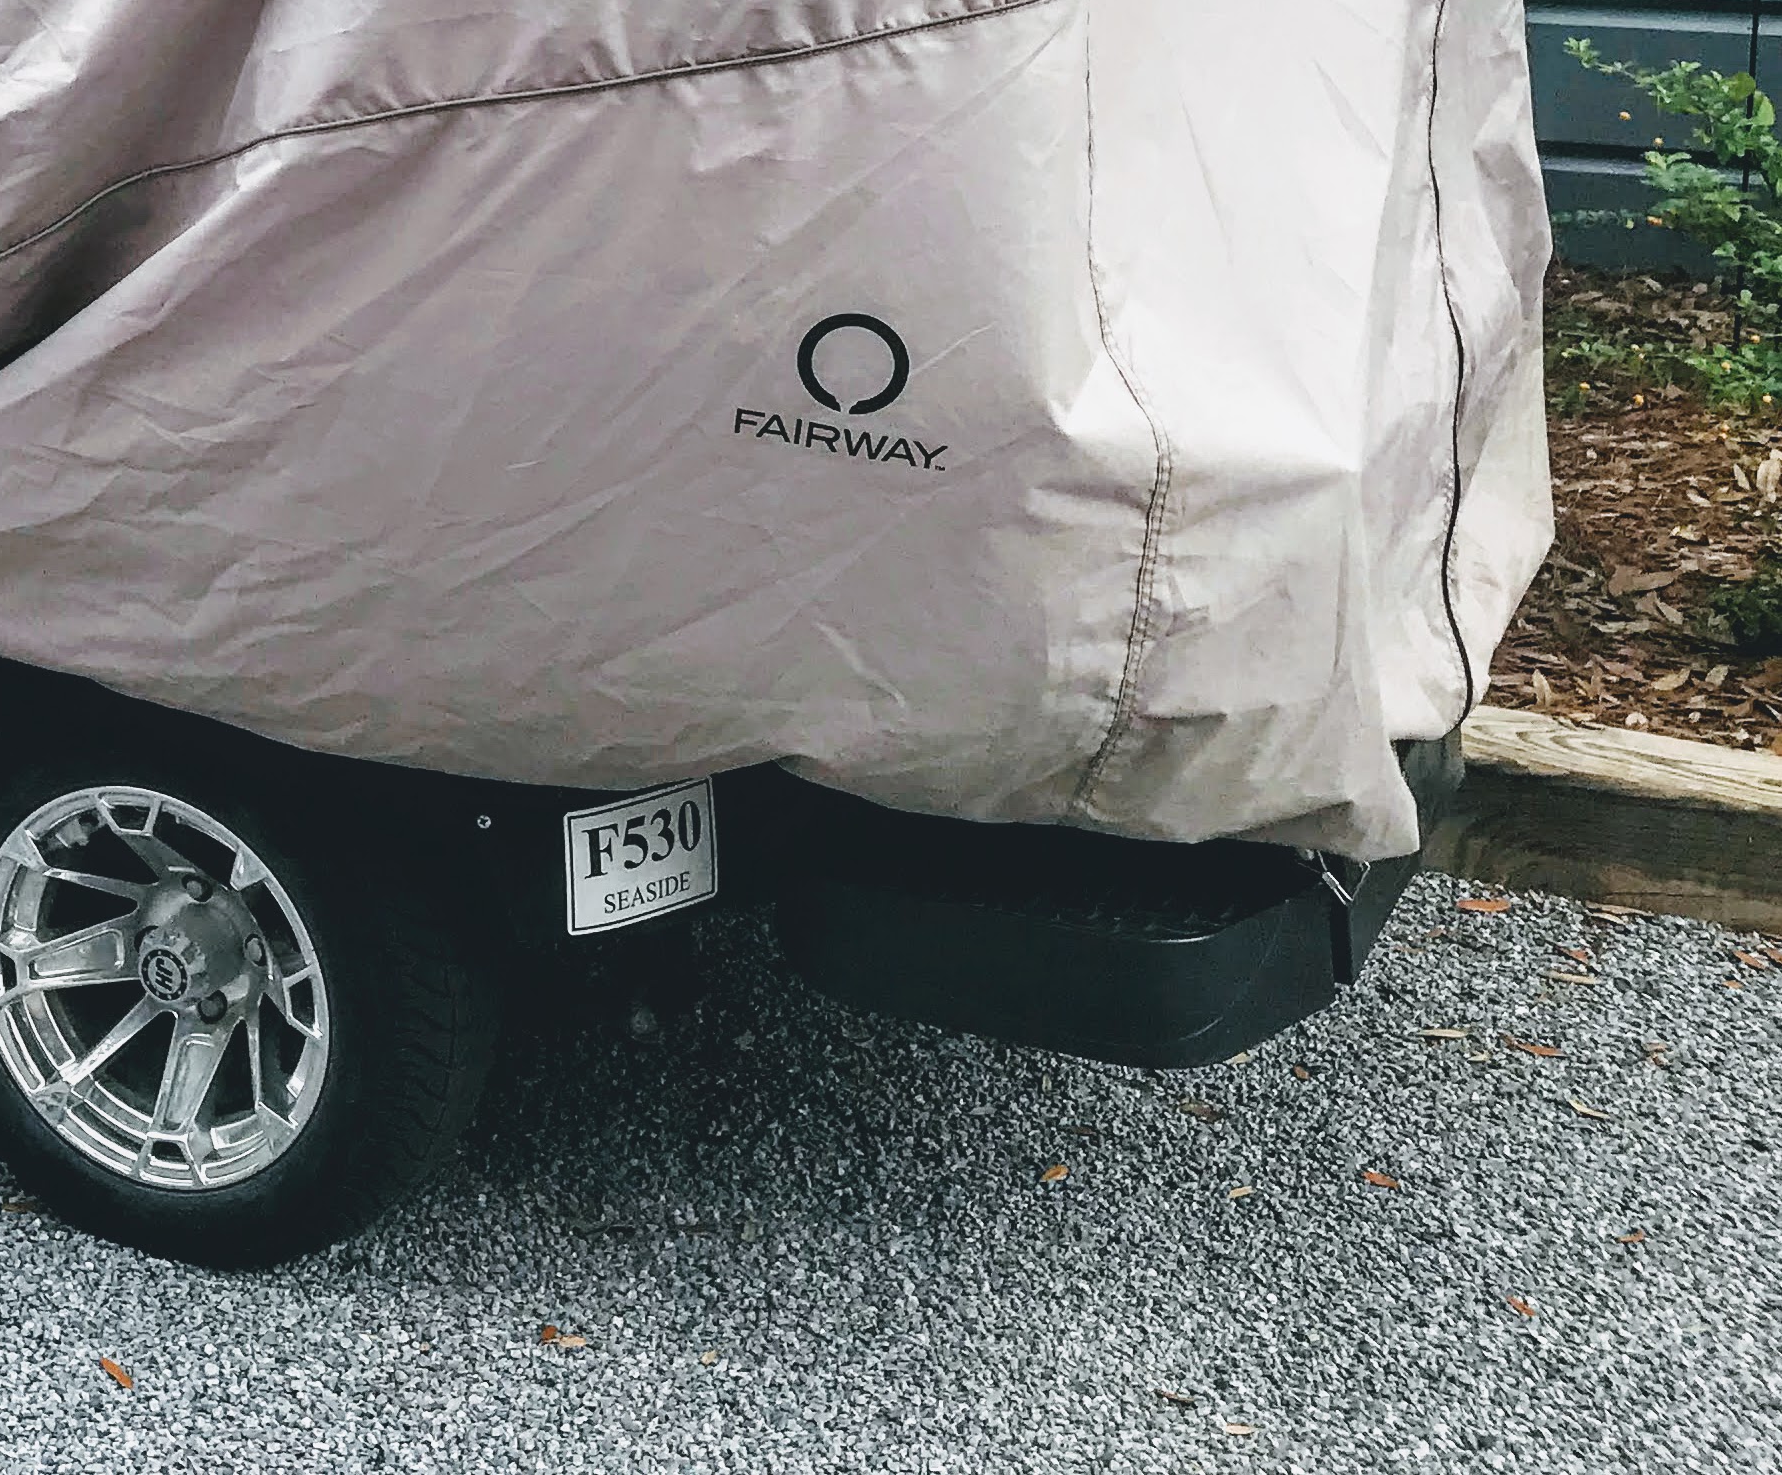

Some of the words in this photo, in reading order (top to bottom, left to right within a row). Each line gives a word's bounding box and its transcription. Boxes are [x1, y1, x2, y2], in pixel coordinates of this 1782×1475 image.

[734, 408, 949, 470] FAIRWAY
[581, 800, 702, 879] F530
[604, 870, 691, 914] SEASIDE
